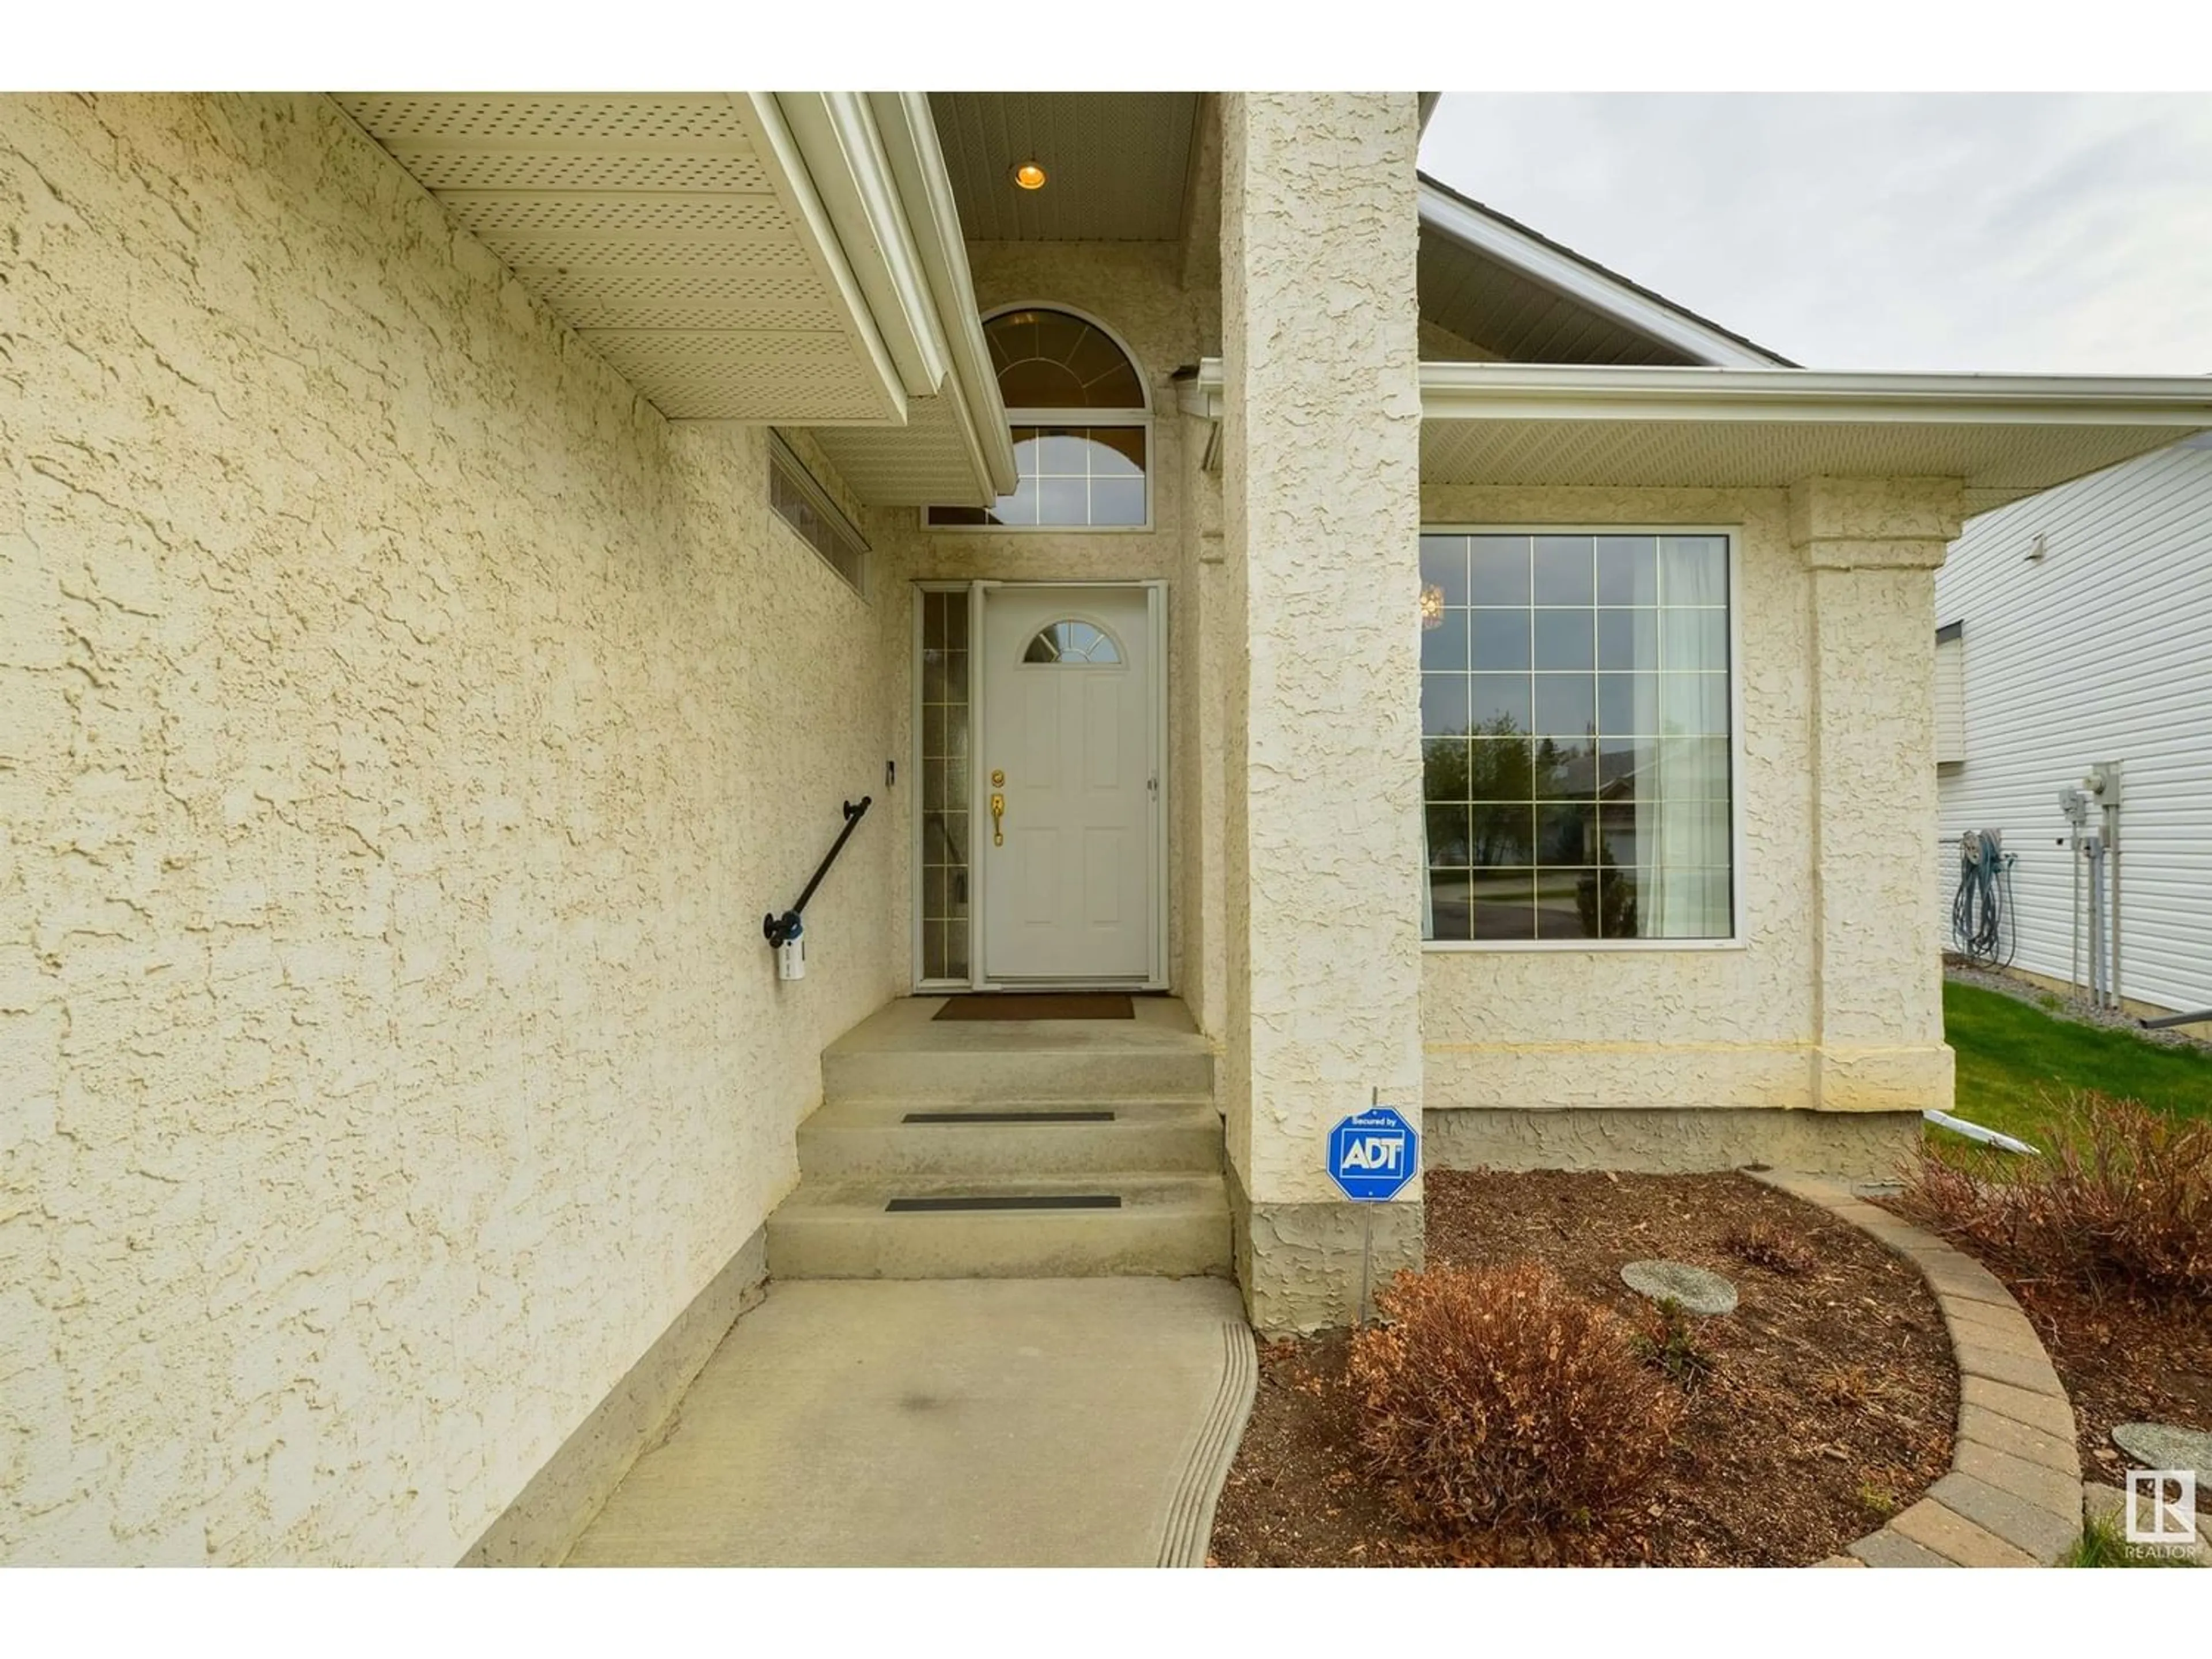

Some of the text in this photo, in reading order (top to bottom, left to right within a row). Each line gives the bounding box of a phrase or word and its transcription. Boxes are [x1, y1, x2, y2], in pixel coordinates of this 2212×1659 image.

[1352, 1116, 1397, 1127] Secured by
[1342, 1137, 1403, 1169] ADT
